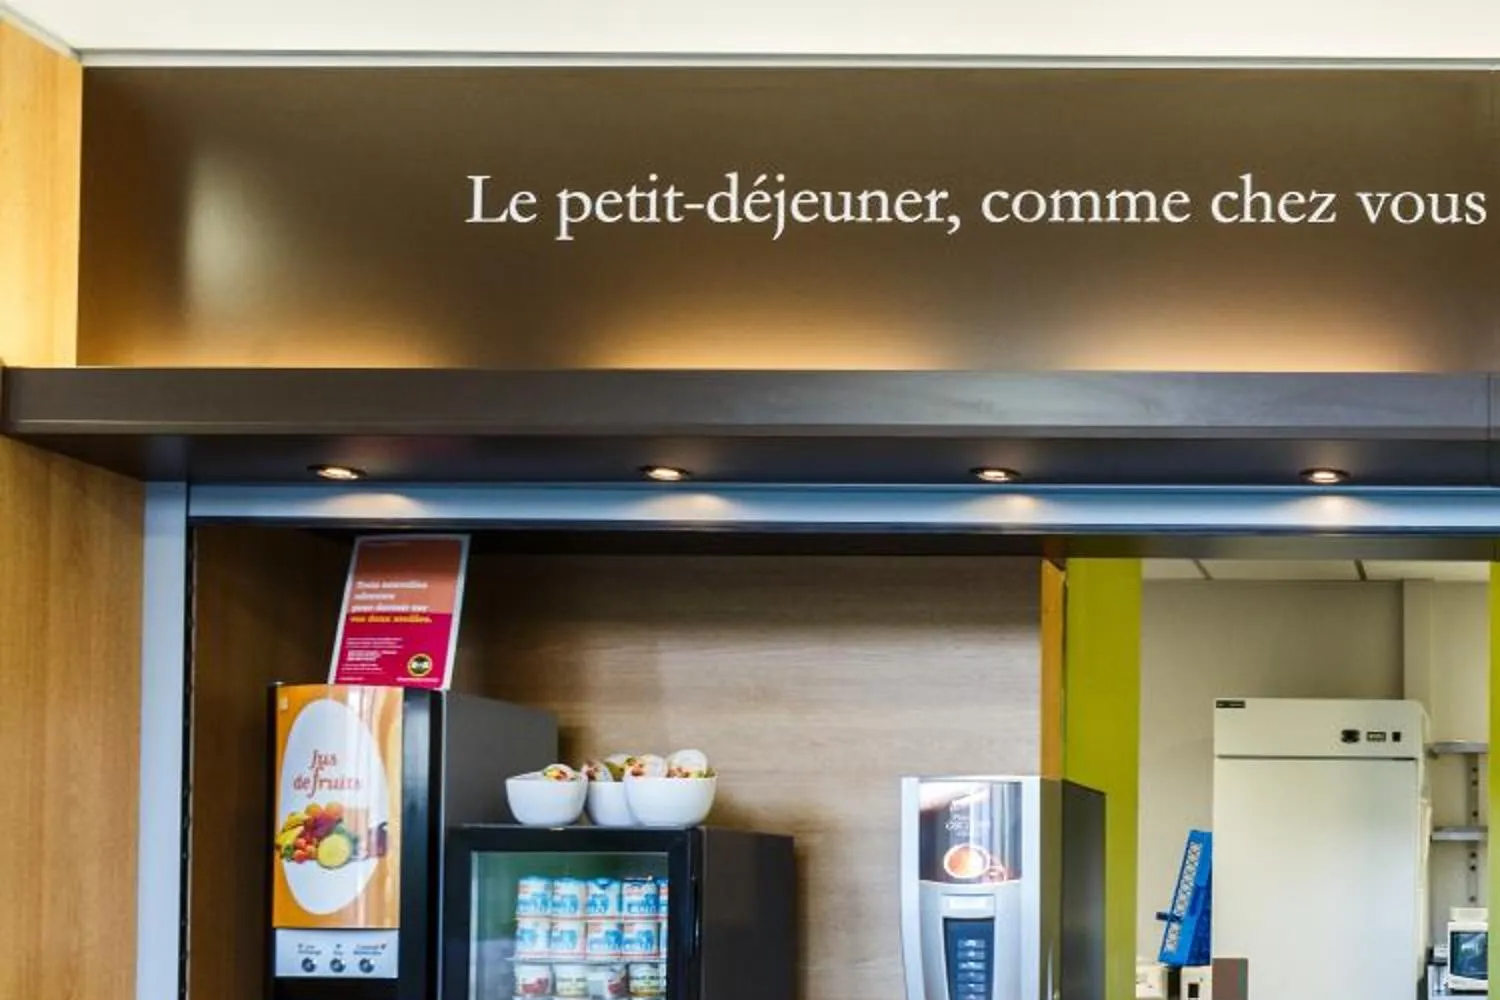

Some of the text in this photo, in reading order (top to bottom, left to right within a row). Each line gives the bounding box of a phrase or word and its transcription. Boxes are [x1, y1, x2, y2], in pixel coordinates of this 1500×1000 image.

[465, 171, 1488, 241] Le petit-déjeuner, comme chez vous
